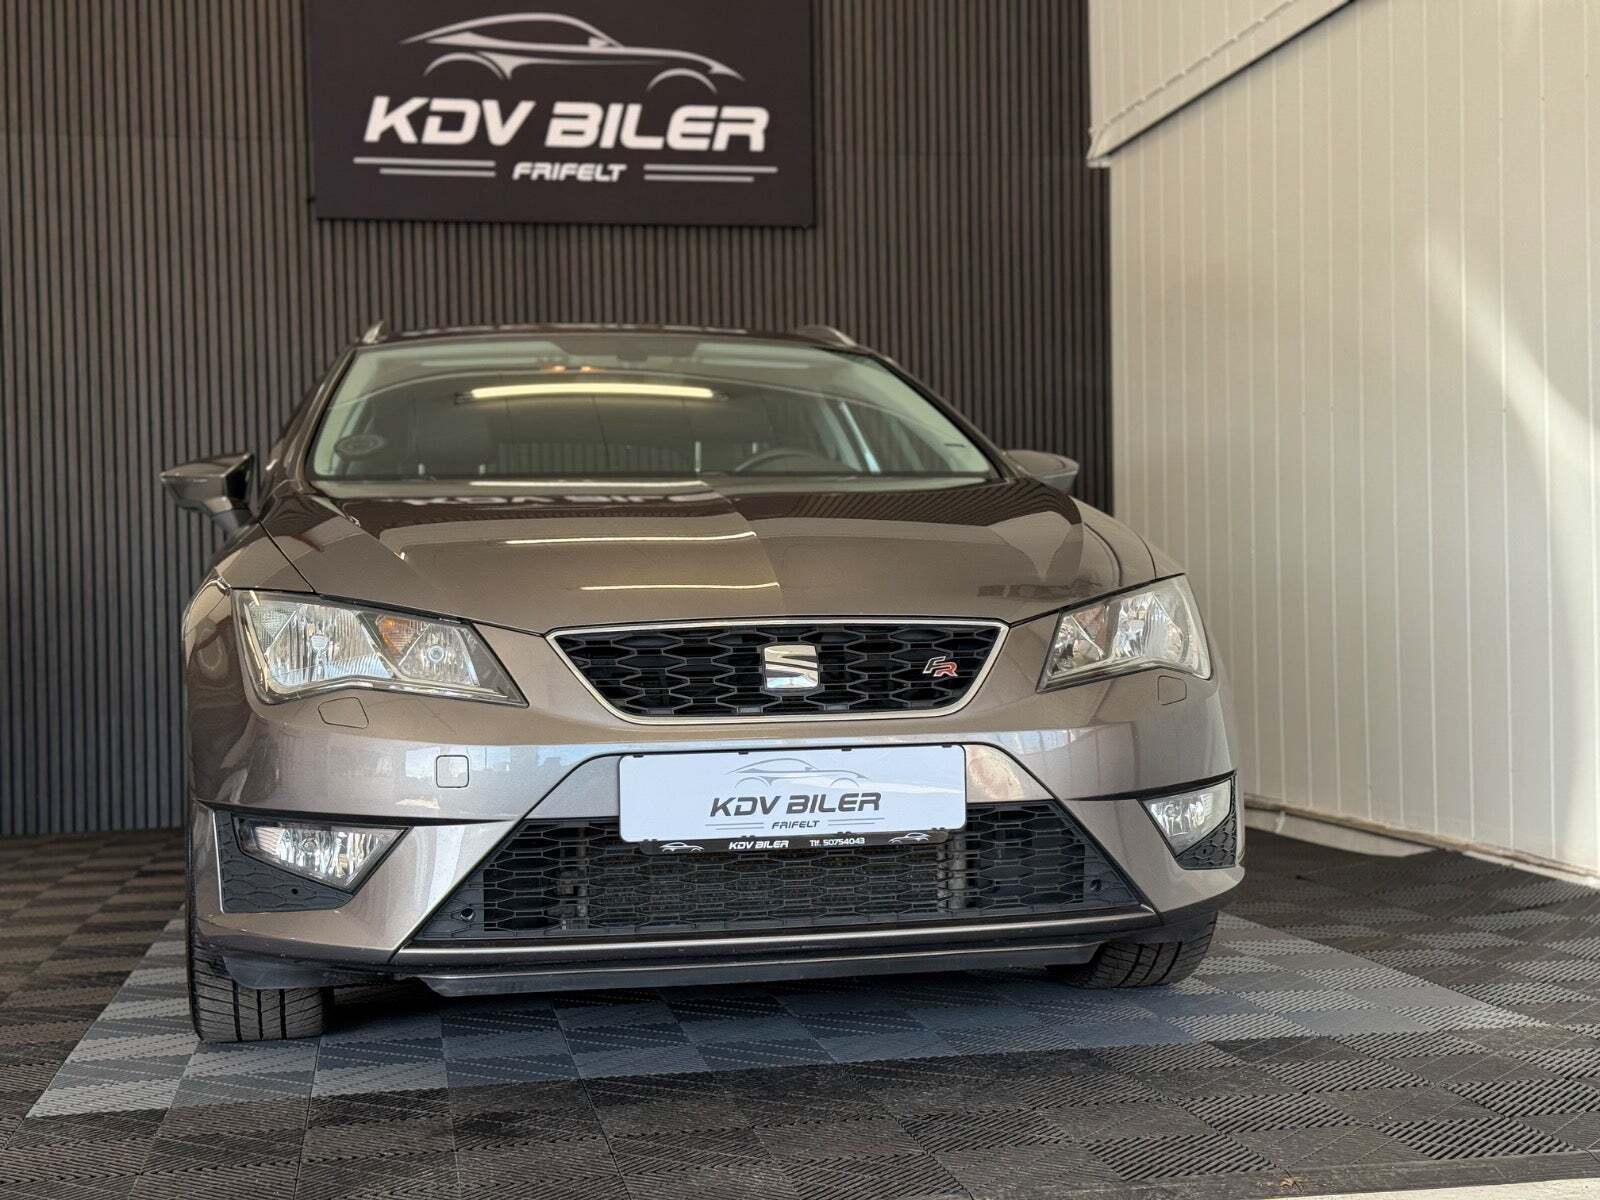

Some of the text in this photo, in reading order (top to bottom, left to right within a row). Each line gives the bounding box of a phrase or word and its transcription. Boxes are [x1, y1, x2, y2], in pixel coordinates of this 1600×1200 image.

[364, 96, 770, 152] KDV BILER
[512, 161, 628, 183] FRIFELT
[922, 656, 958, 677] FR
[710, 792, 881, 817] KDV BILER
[771, 820, 820, 829] FRIFELT
[728, 840, 789, 850] KDV BILER
[823, 837, 865, 846] 50754043
